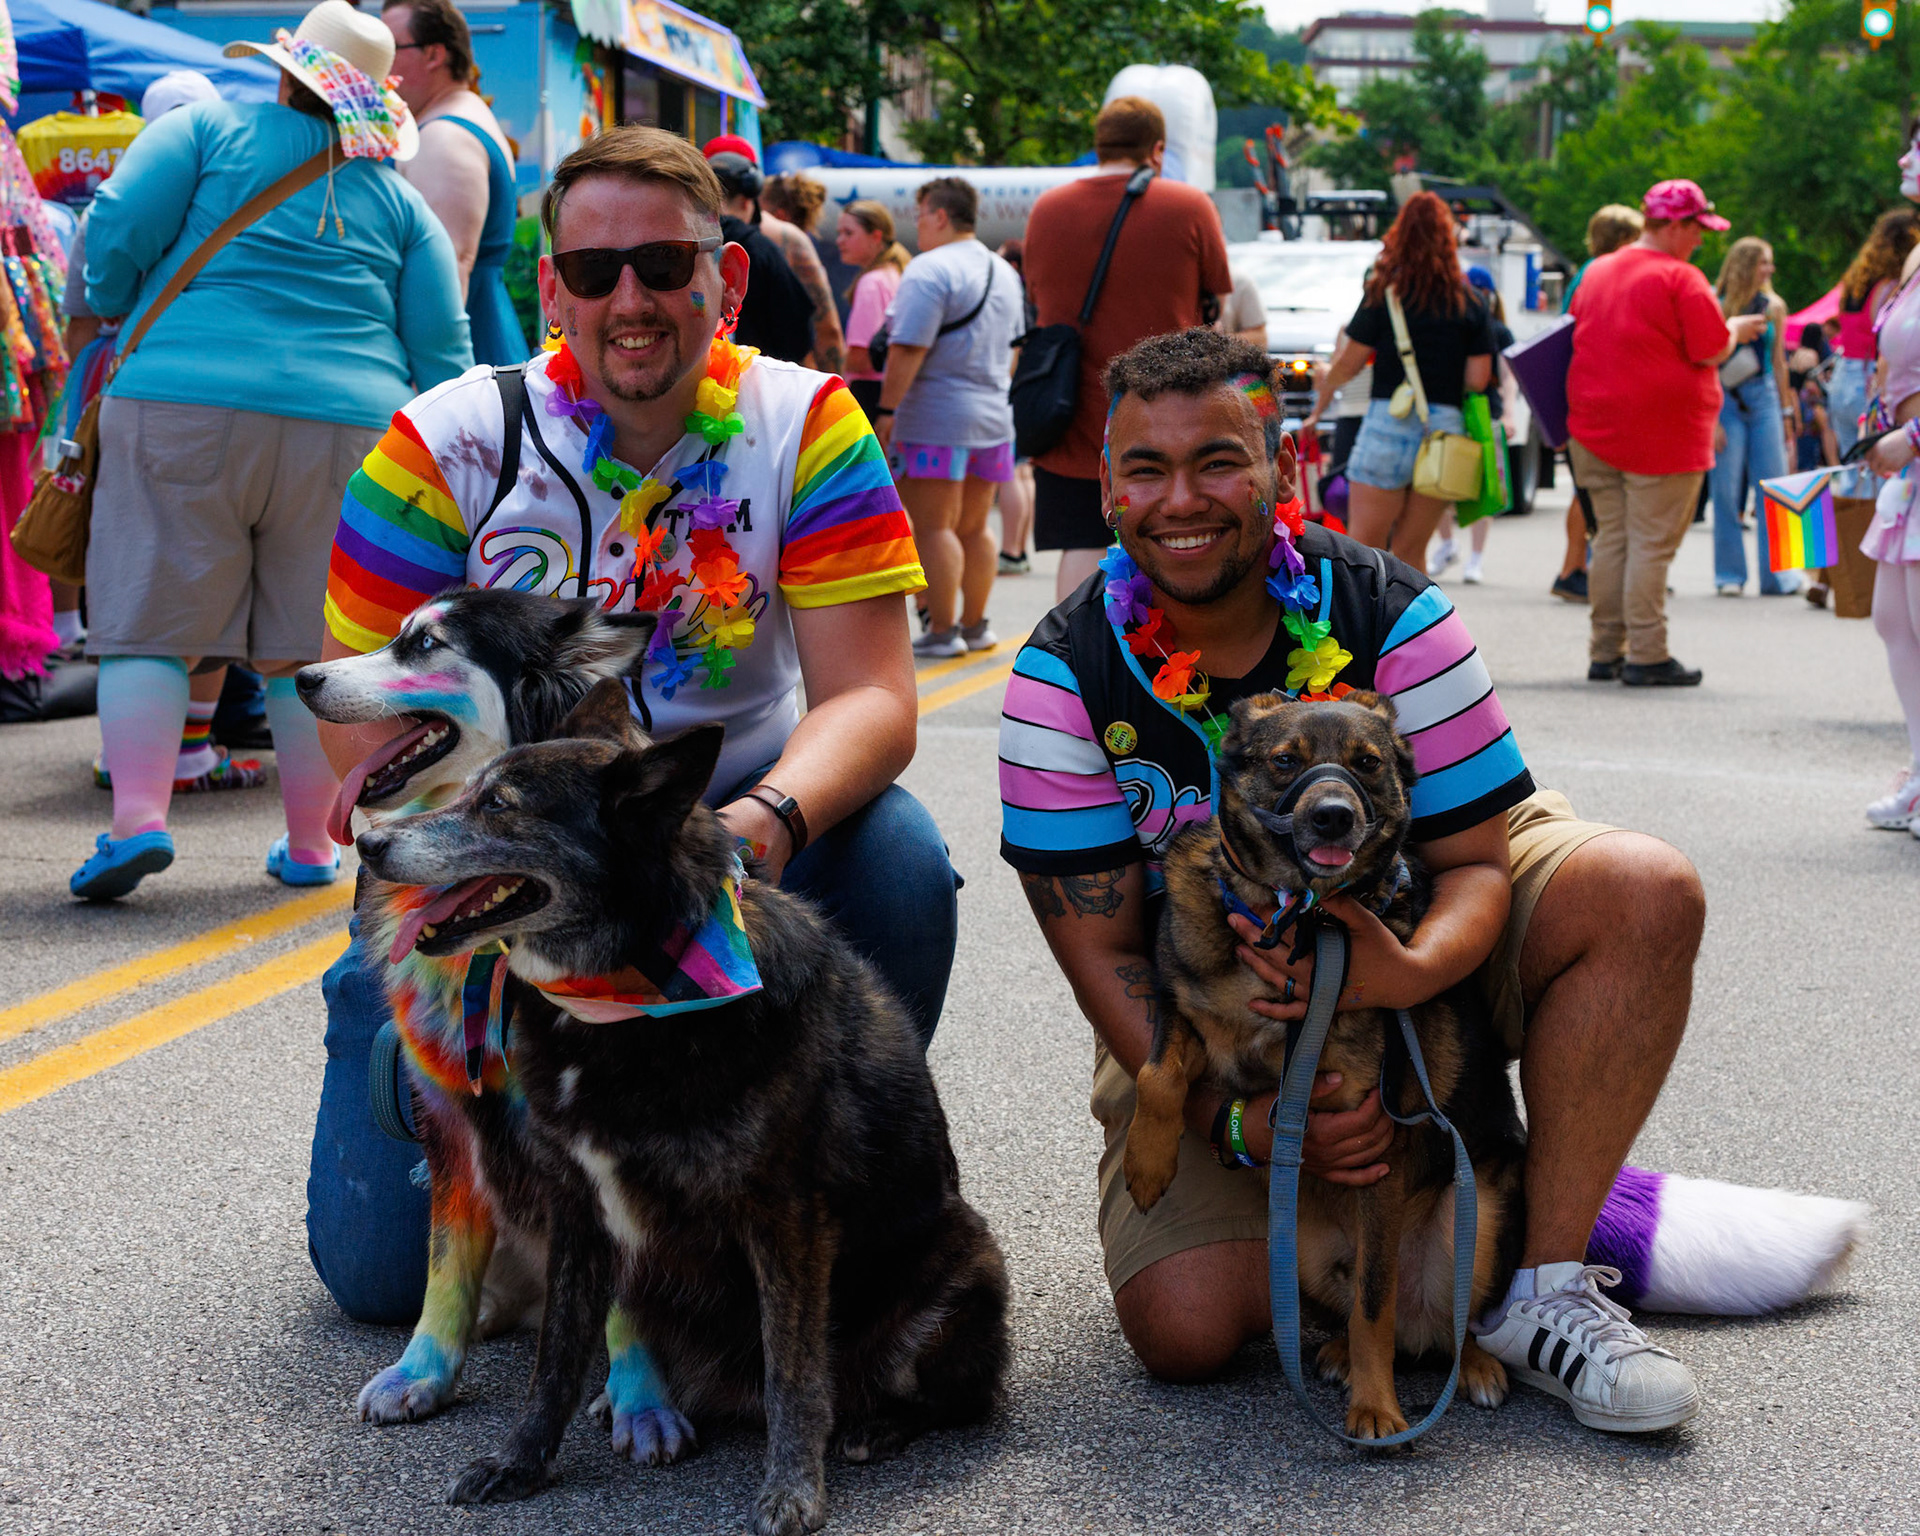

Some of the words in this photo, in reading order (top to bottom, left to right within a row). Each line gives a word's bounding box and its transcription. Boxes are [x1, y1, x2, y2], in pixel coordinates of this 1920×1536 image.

[59, 148, 124, 173] 8647
[664, 498, 753, 541] TM
[1106, 727, 1117, 740] He
[1114, 730, 1128, 748] Him
[1125, 738, 1137, 752] His
[1231, 1106, 1240, 1140] ALONE
